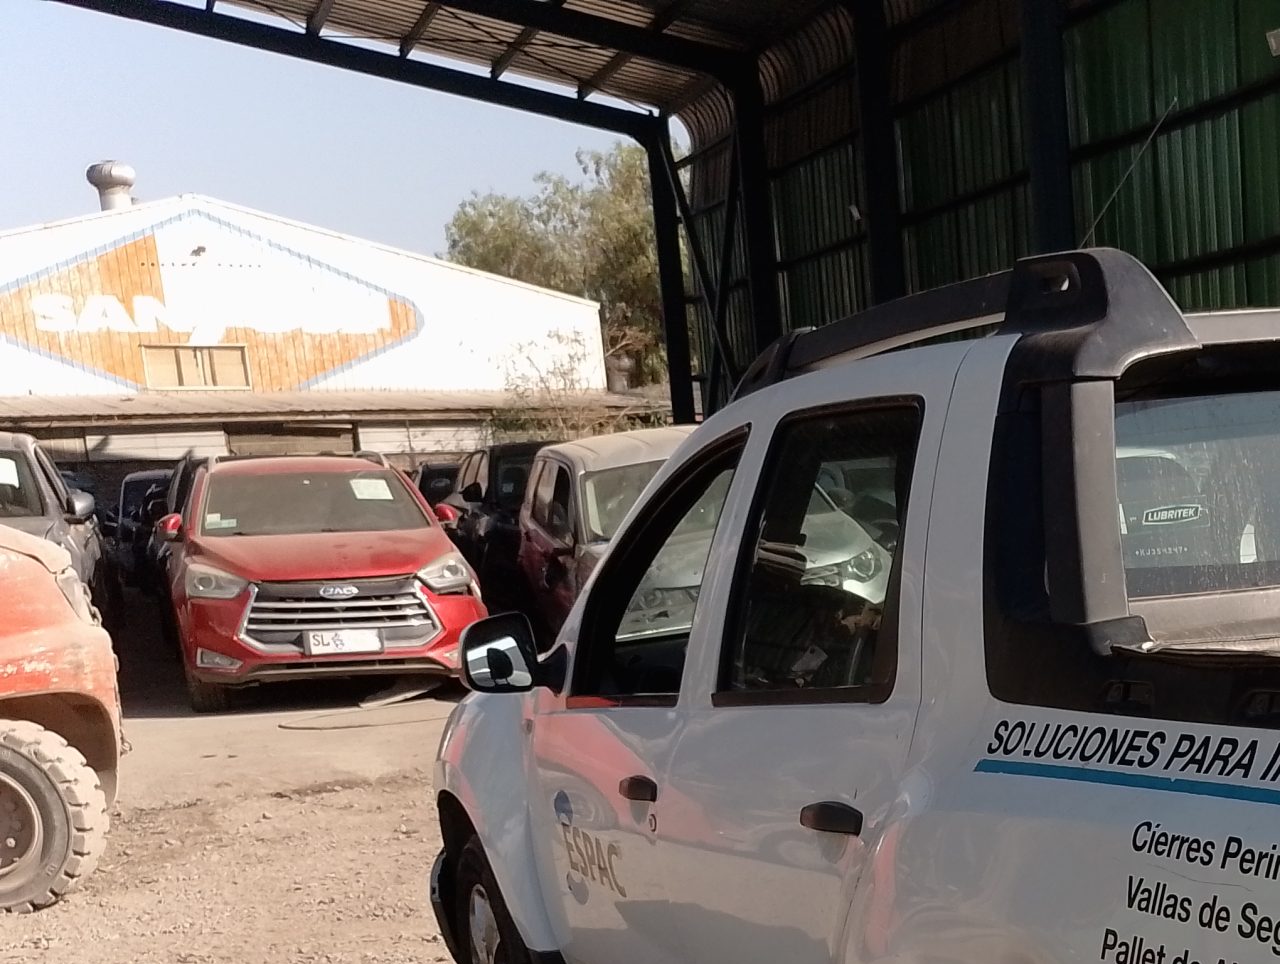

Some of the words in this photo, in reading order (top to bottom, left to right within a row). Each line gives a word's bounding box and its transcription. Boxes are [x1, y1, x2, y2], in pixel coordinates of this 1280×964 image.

[1147, 507, 1197, 521] LUBRITEK
[986, 719, 1167, 770] SOLUCIONES
[1166, 733, 1260, 779] PARA
[562, 822, 628, 898] ESPAC
[1126, 875, 1192, 924] Vallas
[1198, 894, 1230, 932] de
